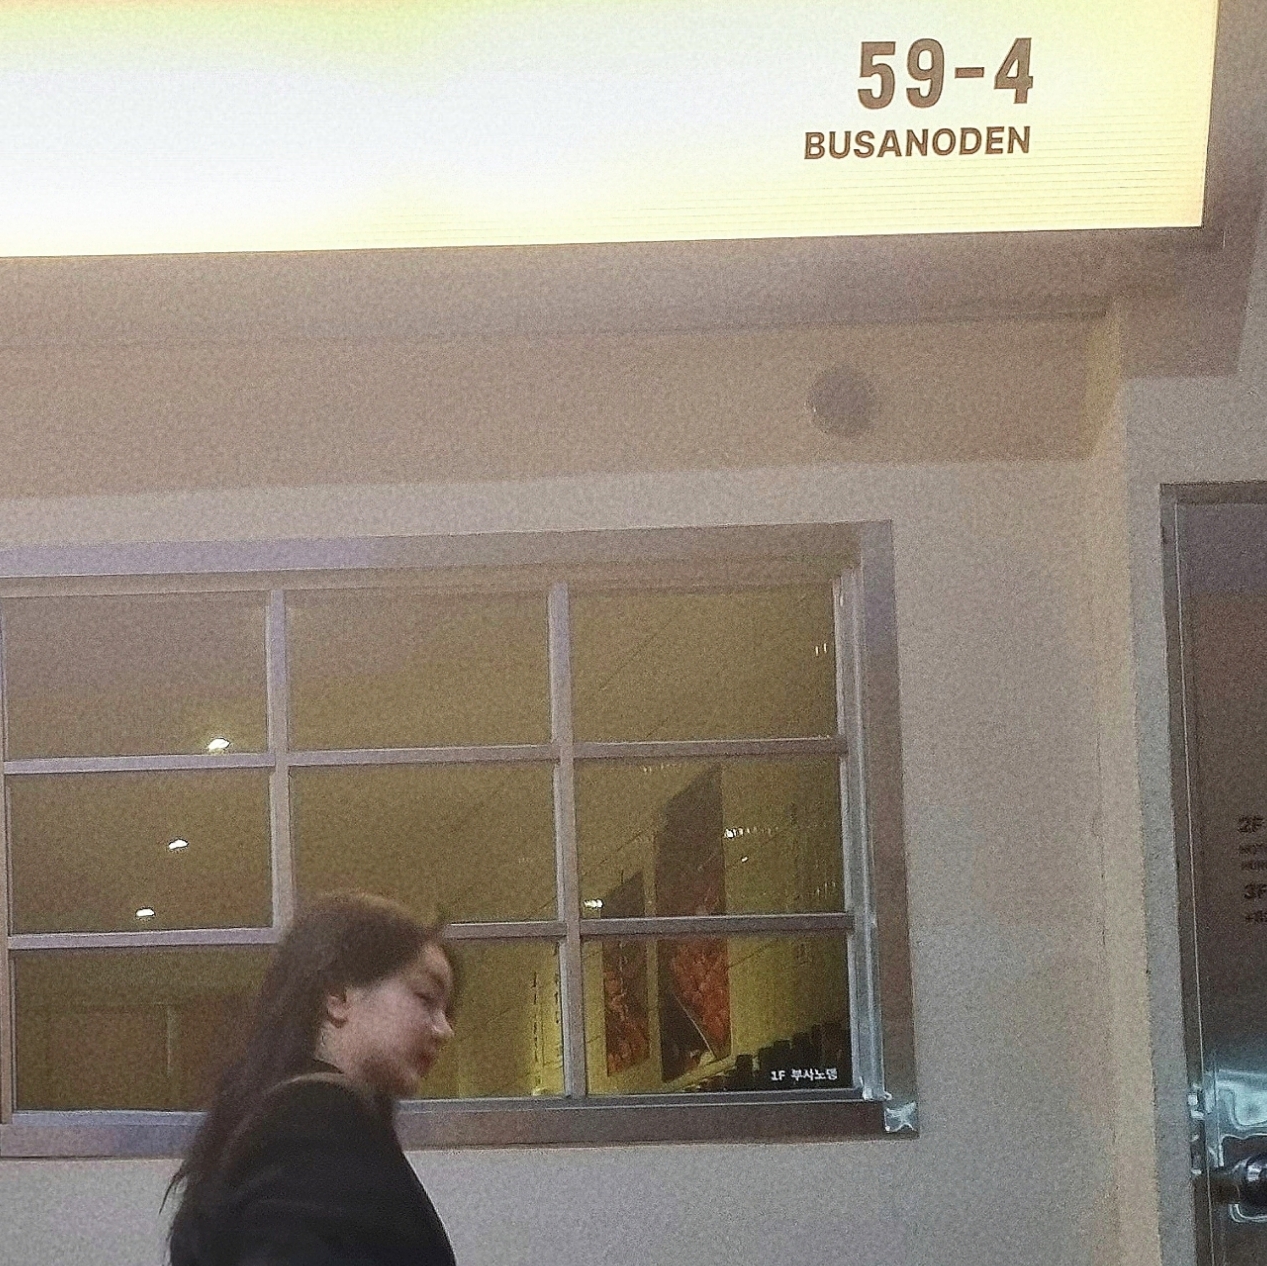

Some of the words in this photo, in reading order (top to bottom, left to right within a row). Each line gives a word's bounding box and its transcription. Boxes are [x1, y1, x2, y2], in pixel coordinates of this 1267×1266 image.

[857, 37, 1034, 110] 59-4
[804, 126, 1031, 159] BUSANODEN
[771, 1070, 786, 1081] 1F
